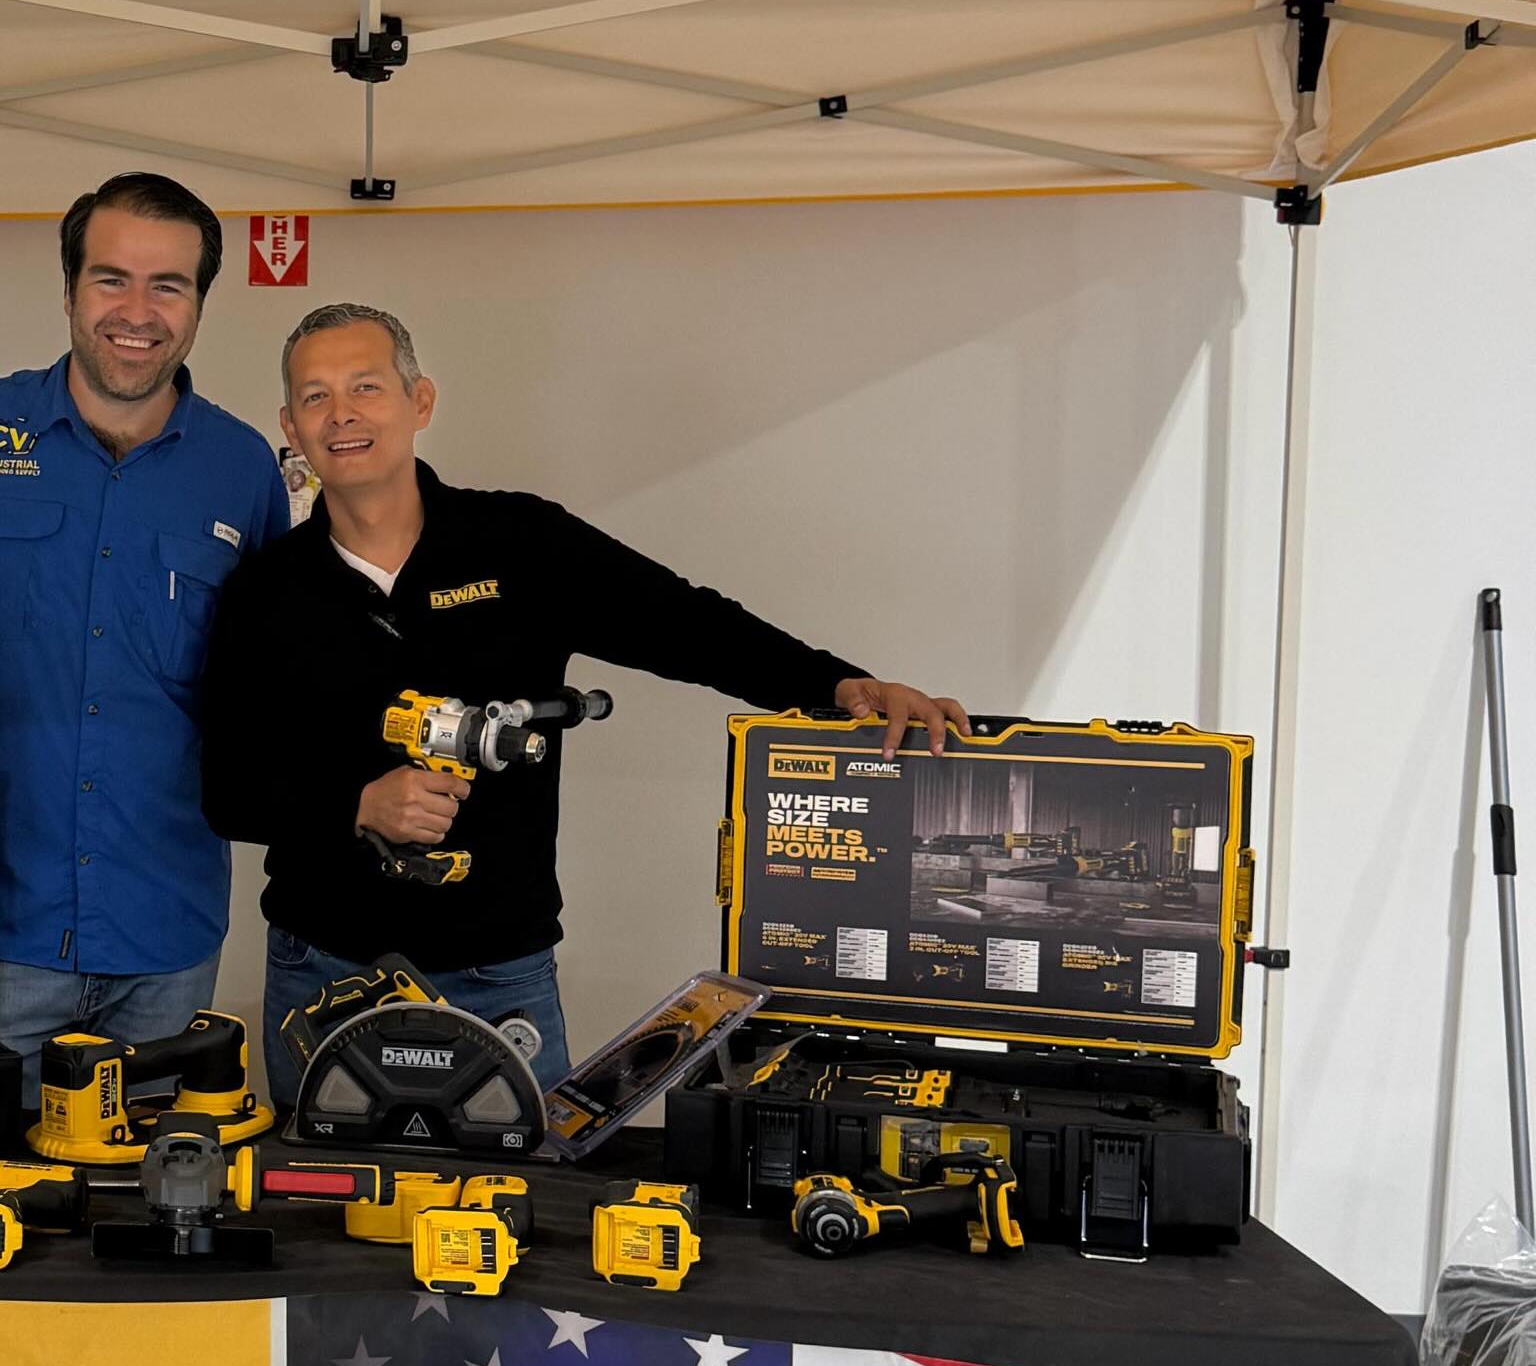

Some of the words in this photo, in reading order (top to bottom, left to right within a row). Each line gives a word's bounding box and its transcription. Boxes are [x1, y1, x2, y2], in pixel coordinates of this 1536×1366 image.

[271, 216, 288, 266] HER
[430, 582, 499, 608] DEWALT
[774, 758, 830, 774] DEWALT
[847, 762, 901, 773] ATOMIC
[768, 792, 869, 813] WHERE
[767, 809, 829, 827] SIZE
[767, 825, 863, 845] MEETS
[382, 1049, 454, 1067] DEWALT
[315, 1123, 334, 1134] XR
